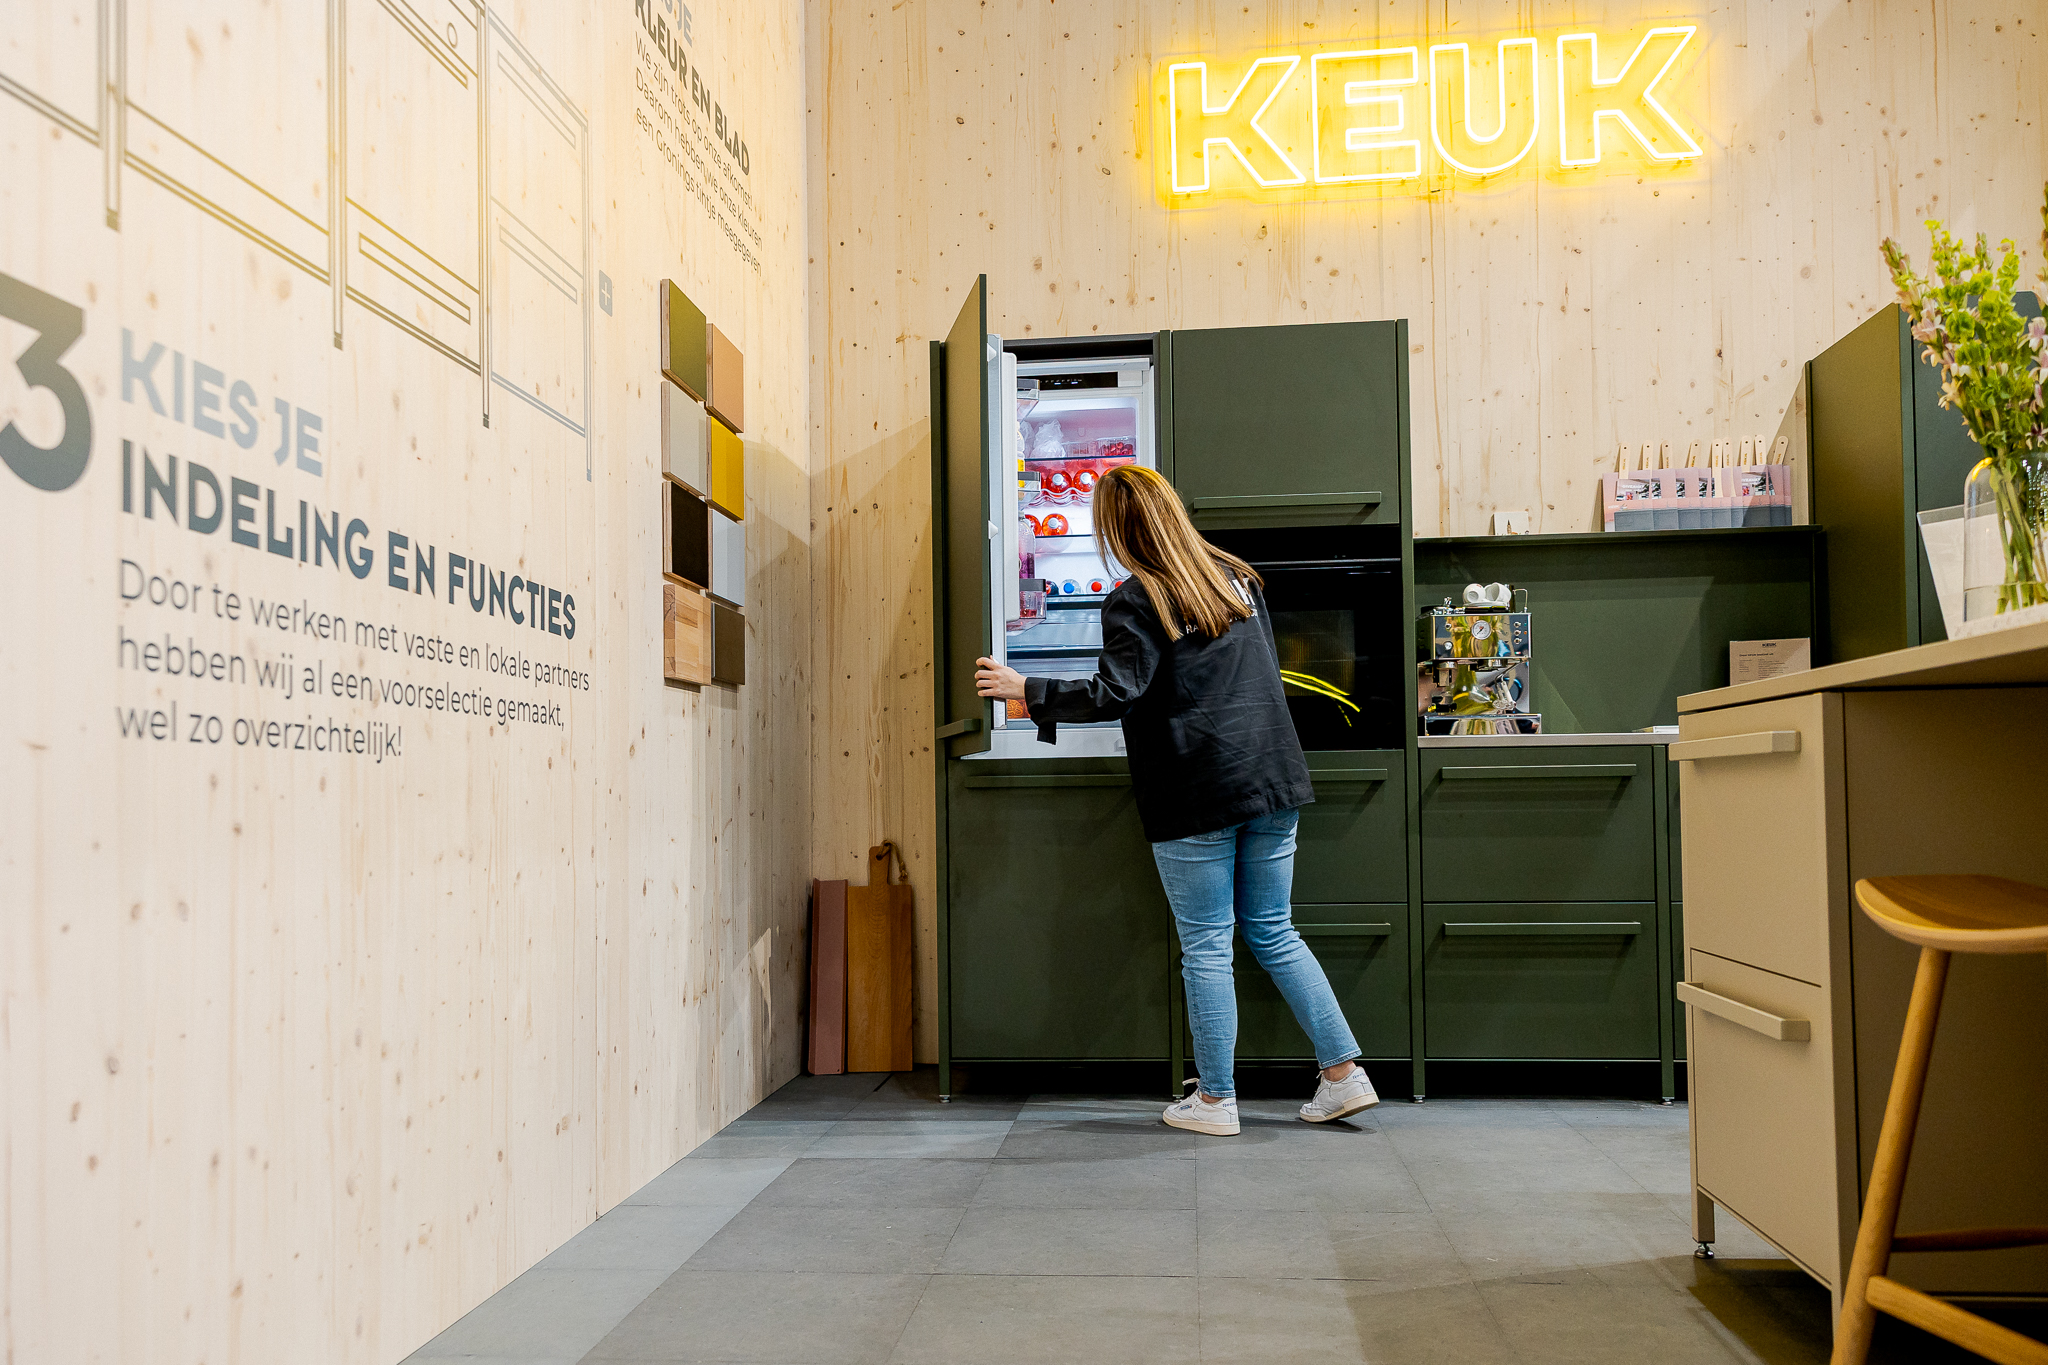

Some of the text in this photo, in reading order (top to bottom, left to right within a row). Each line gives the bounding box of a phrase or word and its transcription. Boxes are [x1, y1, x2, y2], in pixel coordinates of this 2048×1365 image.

[635, 30, 651, 70] We
[653, 63, 669, 96] zijn
[671, 85, 690, 125] trots
[692, 119, 702, 143] op
[704, 136, 721, 169] onze
[636, 67, 763, 251] Daarom hebben we onze kleuren
[692, 65, 711, 122] EN
[715, 101, 750, 175] BLAD
[1168, 25, 1704, 194] KEUK
[636, 107, 762, 277] een Gronings tintje meegegeven
[0, 271, 94, 491] 3
[121, 326, 323, 478] KIES JE
[121, 438, 576, 640] INDELING EN FUNCTIES
[118, 625, 565, 731] hebben wij al een voorselectie gemaakt,
[119, 558, 590, 691] Door te werken met vaste en lokale partners
[116, 700, 403, 764] wel zo overzichtelijk!
